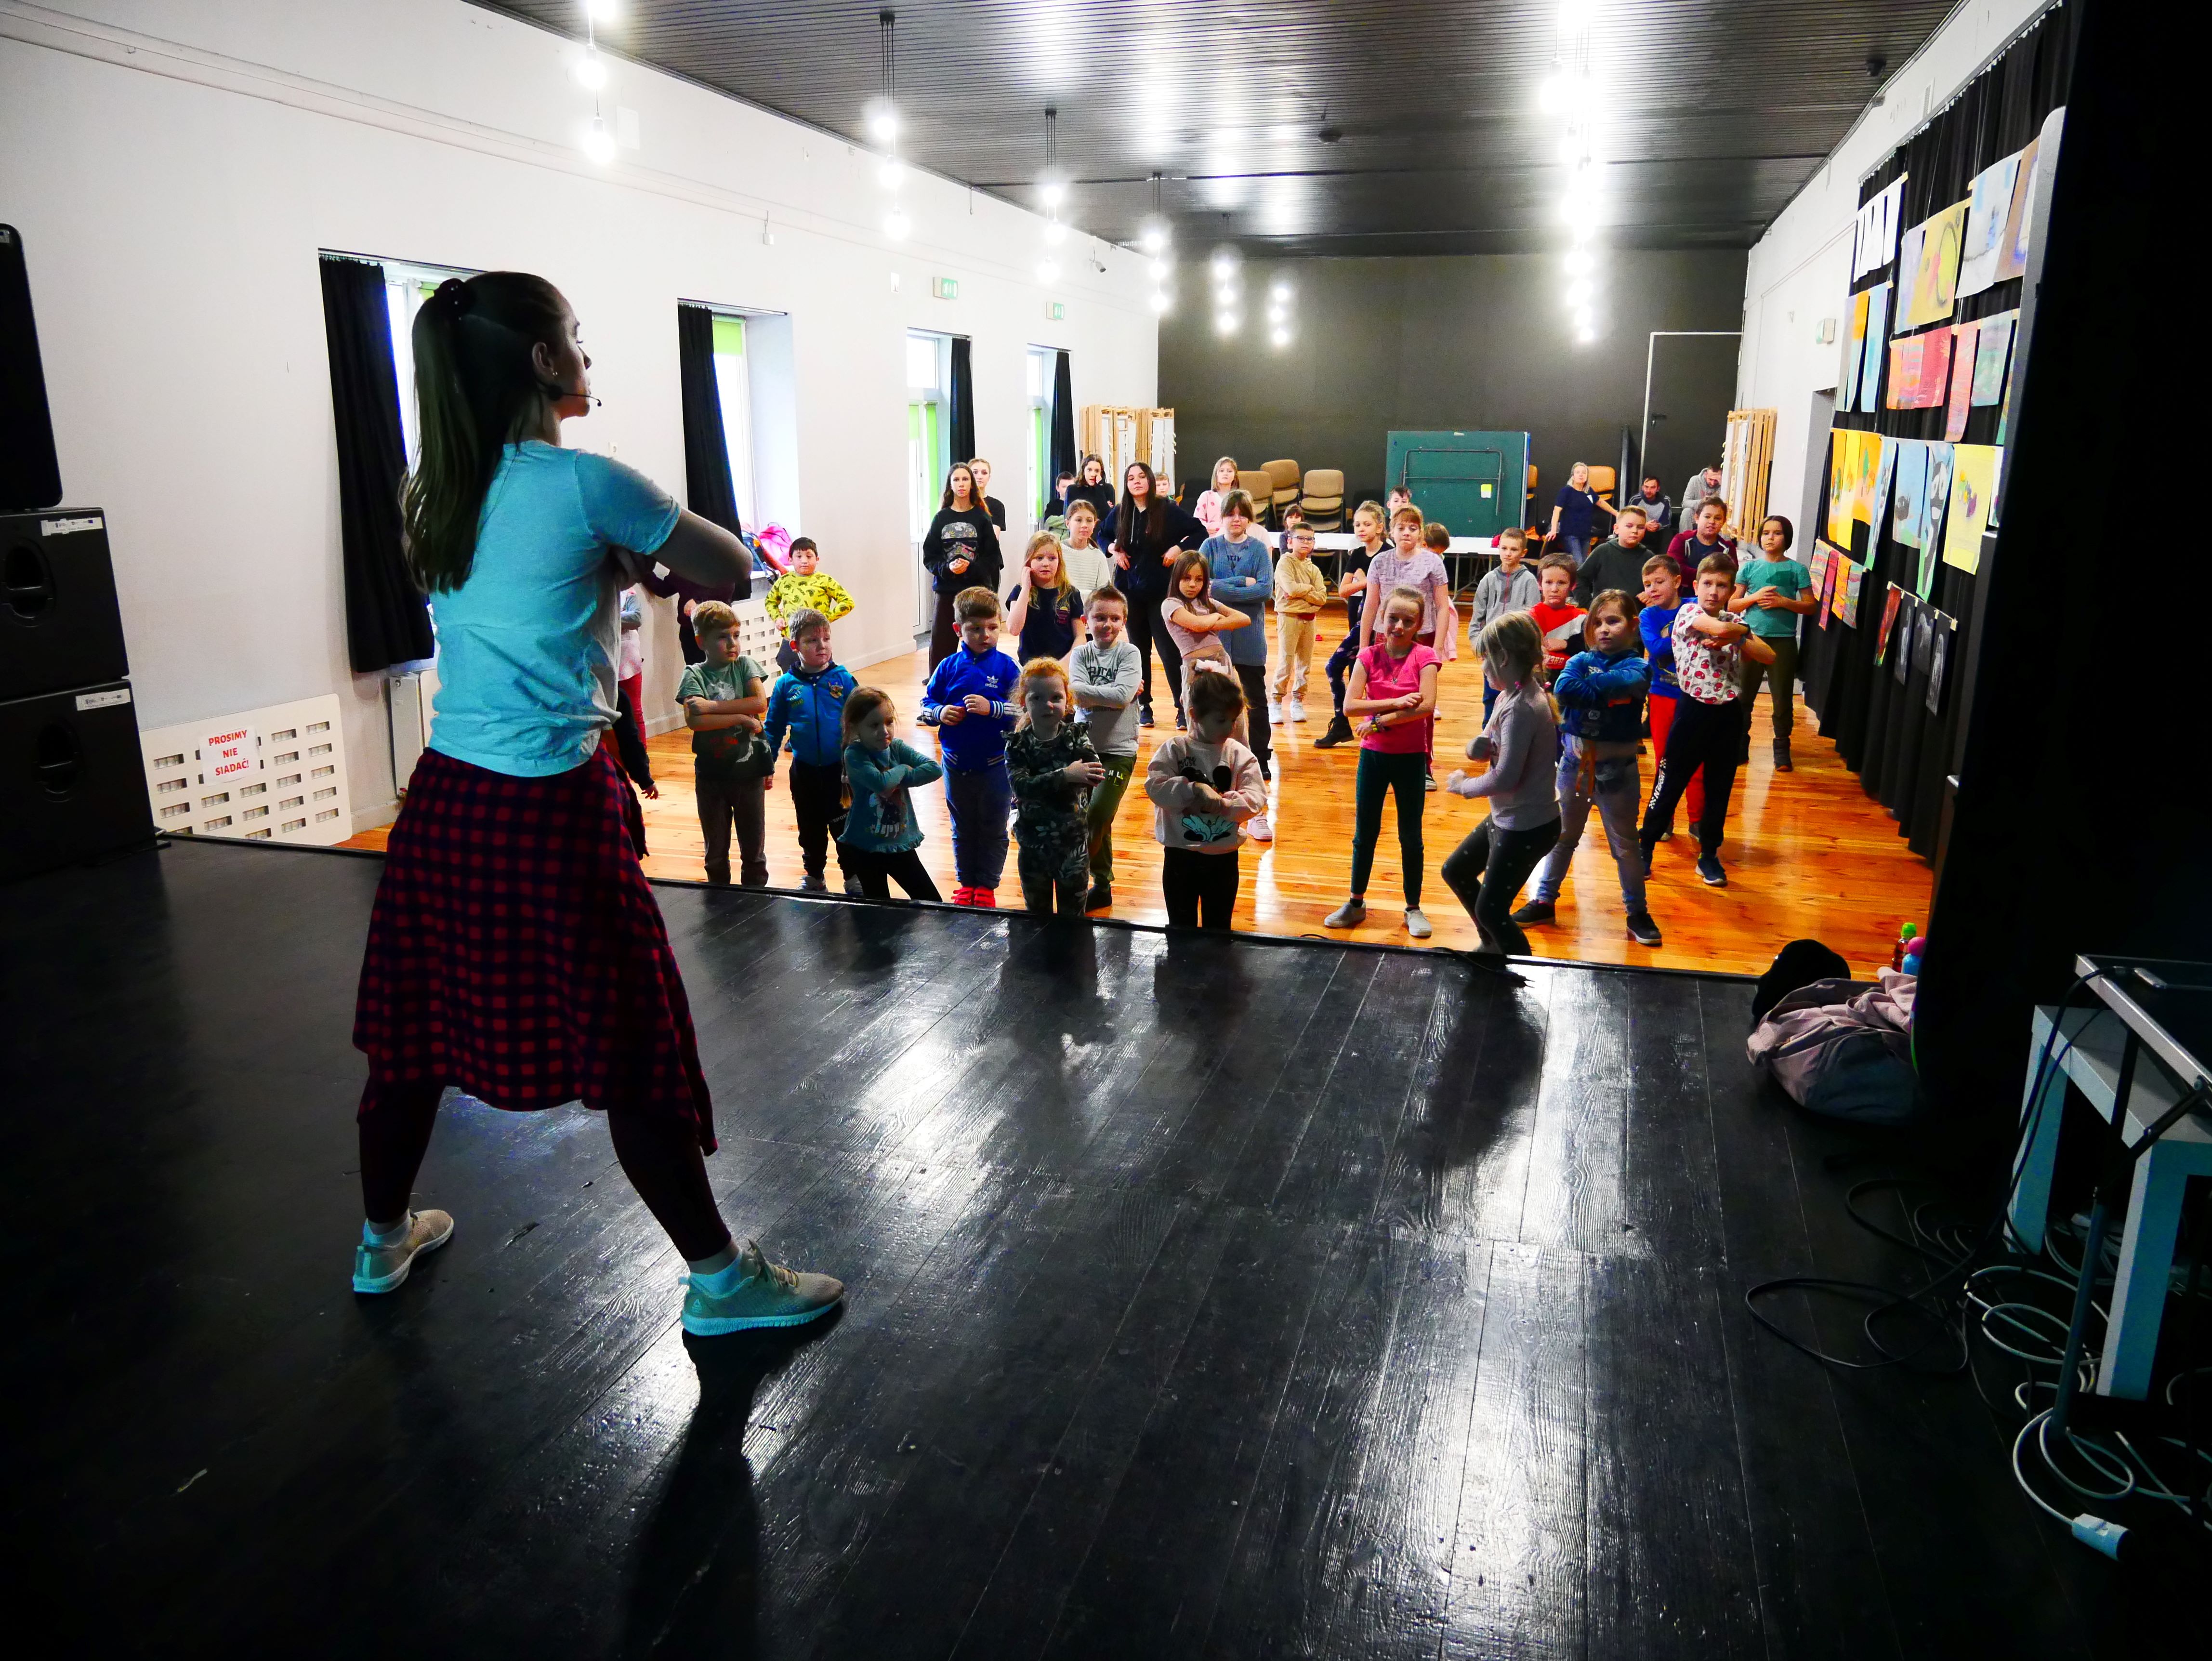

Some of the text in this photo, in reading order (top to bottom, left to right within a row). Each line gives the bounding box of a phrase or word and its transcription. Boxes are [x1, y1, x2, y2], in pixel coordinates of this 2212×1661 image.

[209, 729, 247, 746] PROSIMY
[223, 748, 238, 758] NIE
[215, 758, 249, 776] SIADAĆ!
